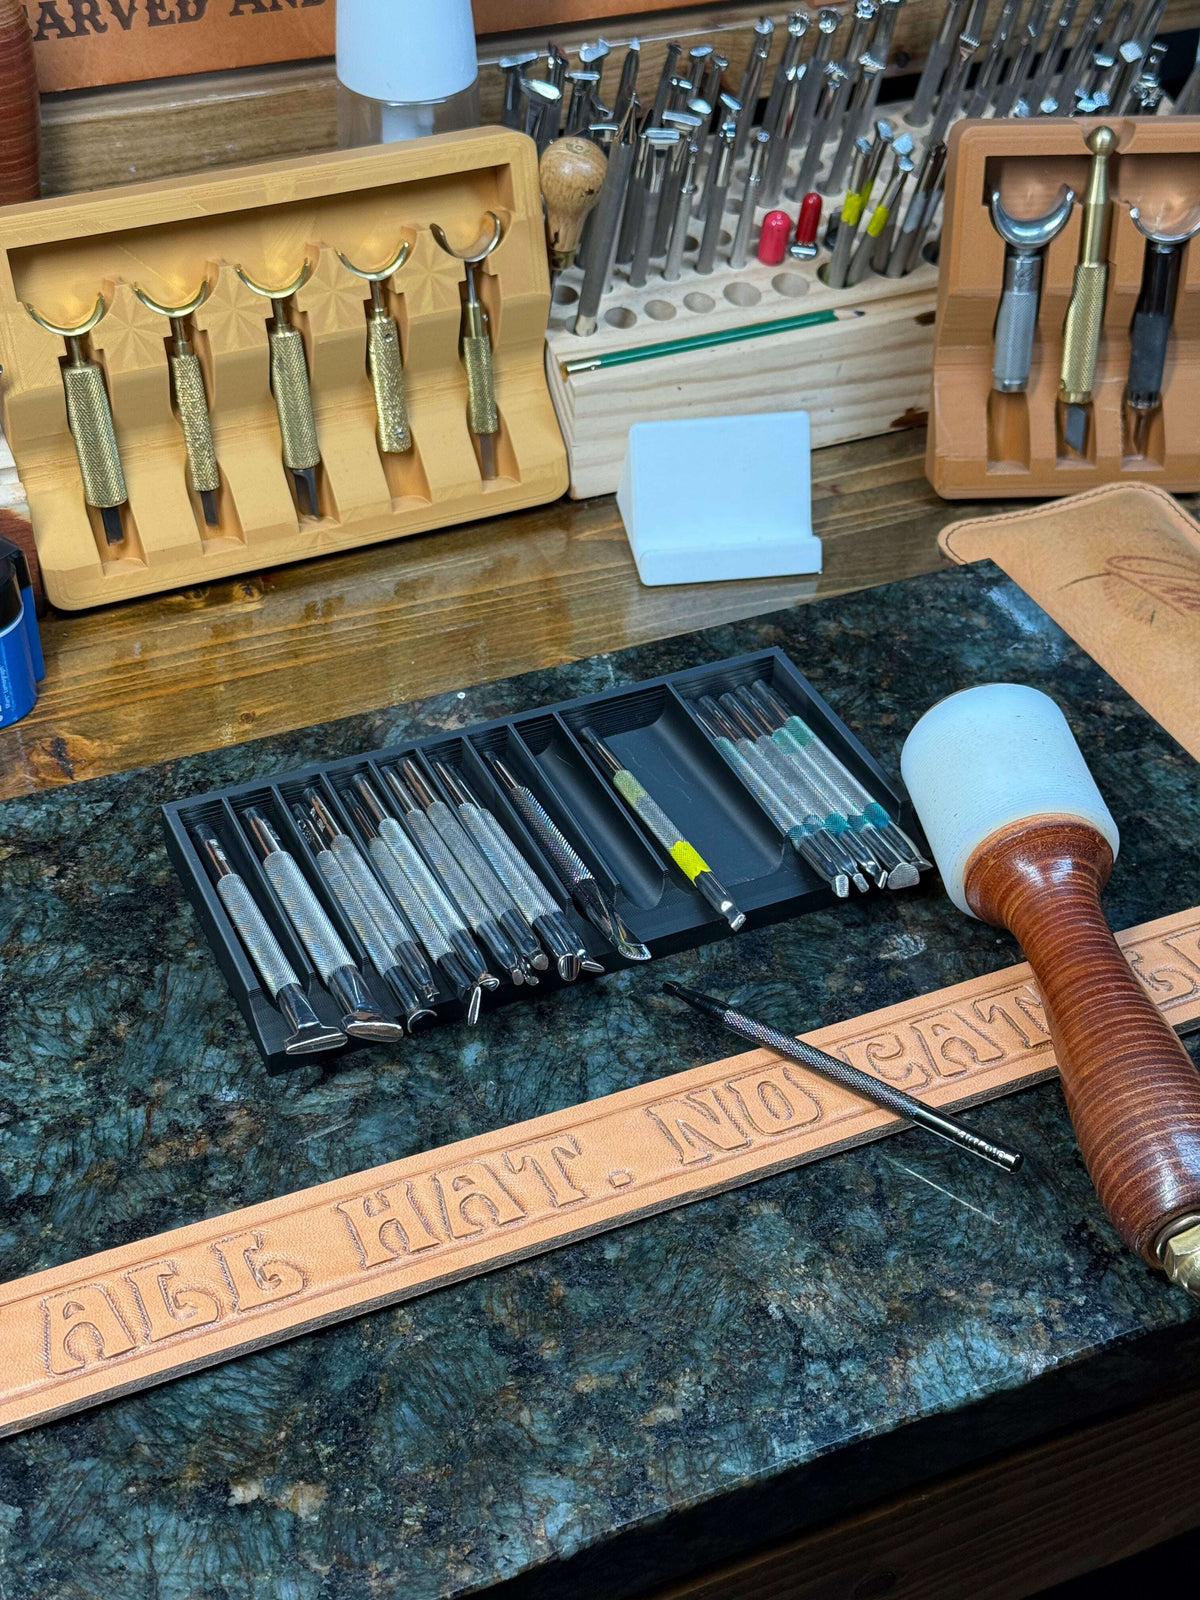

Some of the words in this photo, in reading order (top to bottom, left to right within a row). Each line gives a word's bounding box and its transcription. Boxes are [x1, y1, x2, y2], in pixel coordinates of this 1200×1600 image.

[23, 0, 207, 41] ARVED
[43, 1231, 305, 1376] ALL
[335, 1134, 631, 1268] HAT.
[645, 1065, 822, 1164] NO
